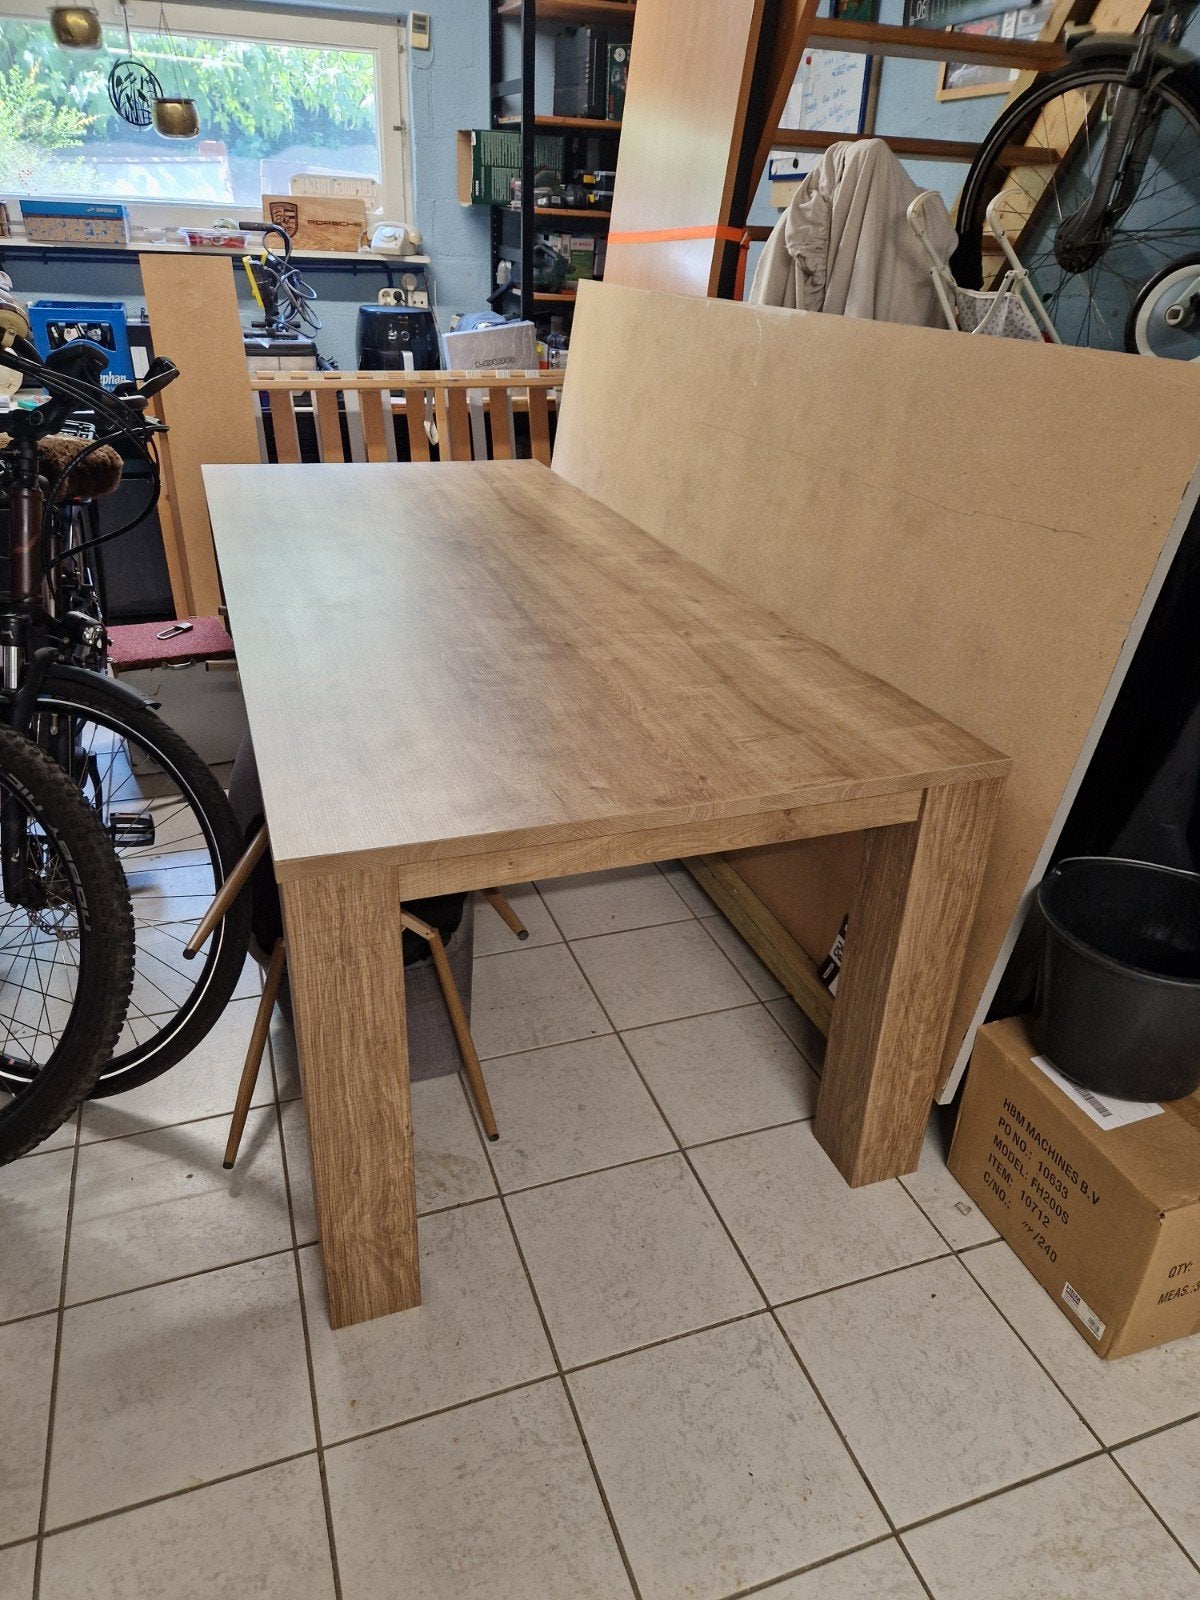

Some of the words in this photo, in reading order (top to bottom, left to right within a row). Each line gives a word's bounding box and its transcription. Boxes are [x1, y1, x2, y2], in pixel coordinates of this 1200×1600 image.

[306, 219, 363, 227] PORSCHE
[983, 1171, 1012, 1209] C/NO.:
[993, 1134, 1029, 1180] MODEL:
[1030, 1177, 1070, 1225] FH200S
[998, 1116, 1012, 1135] PO
[1012, 1131, 1033, 1159] NO.:
[1038, 1160, 1069, 1199] 10633
[1003, 1098, 1025, 1126] HBM
[1026, 1122, 1079, 1184] MACHINES
[1080, 1180, 1101, 1205] B.V
[989, 1152, 1014, 1187] ITEM:
[1021, 1190, 1050, 1229] 10712
[1168, 1260, 1194, 1279] QTY:
